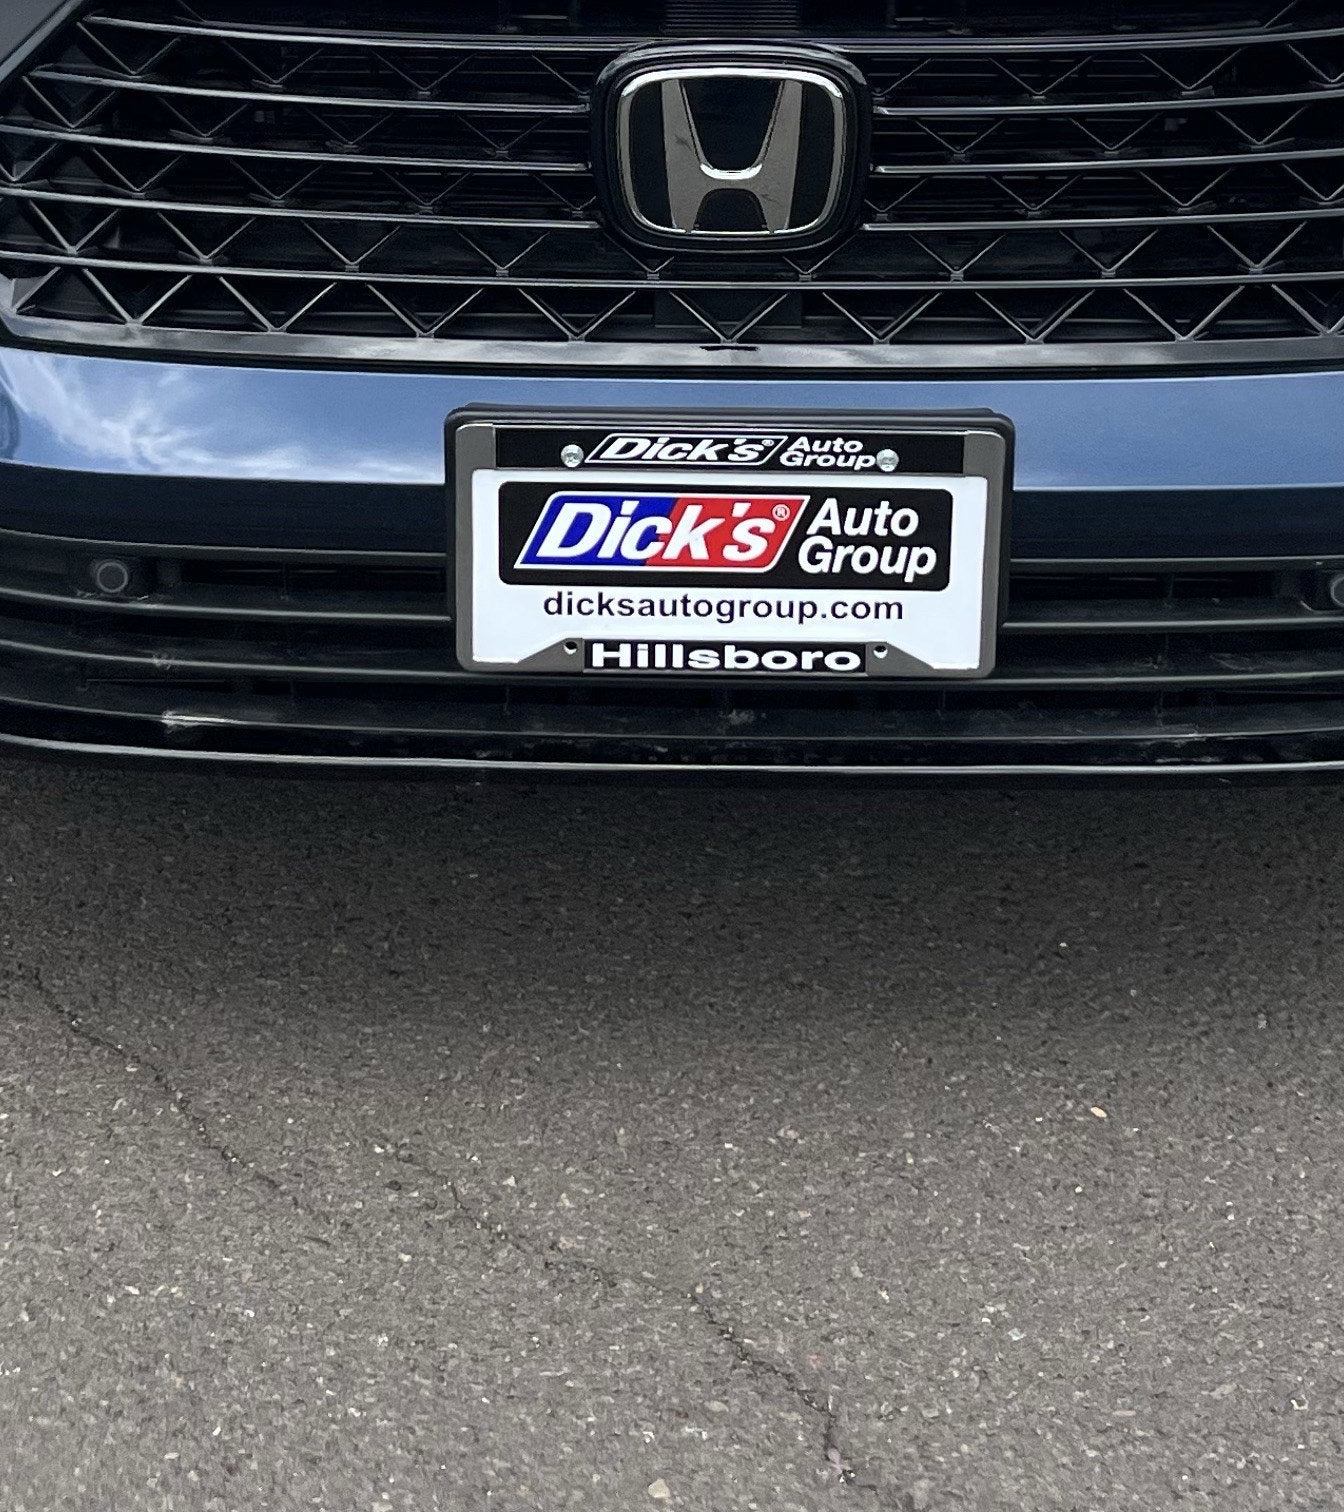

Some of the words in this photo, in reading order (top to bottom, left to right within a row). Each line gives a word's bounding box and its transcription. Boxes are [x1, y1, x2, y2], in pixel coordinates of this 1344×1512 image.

[778, 450, 877, 471] Group
[786, 436, 864, 454] Auto
[805, 497, 920, 538] Auto
[797, 536, 938, 583] Group
[542, 591, 904, 625] dicksautogroup.com
[591, 642, 862, 672] Hillsboro
